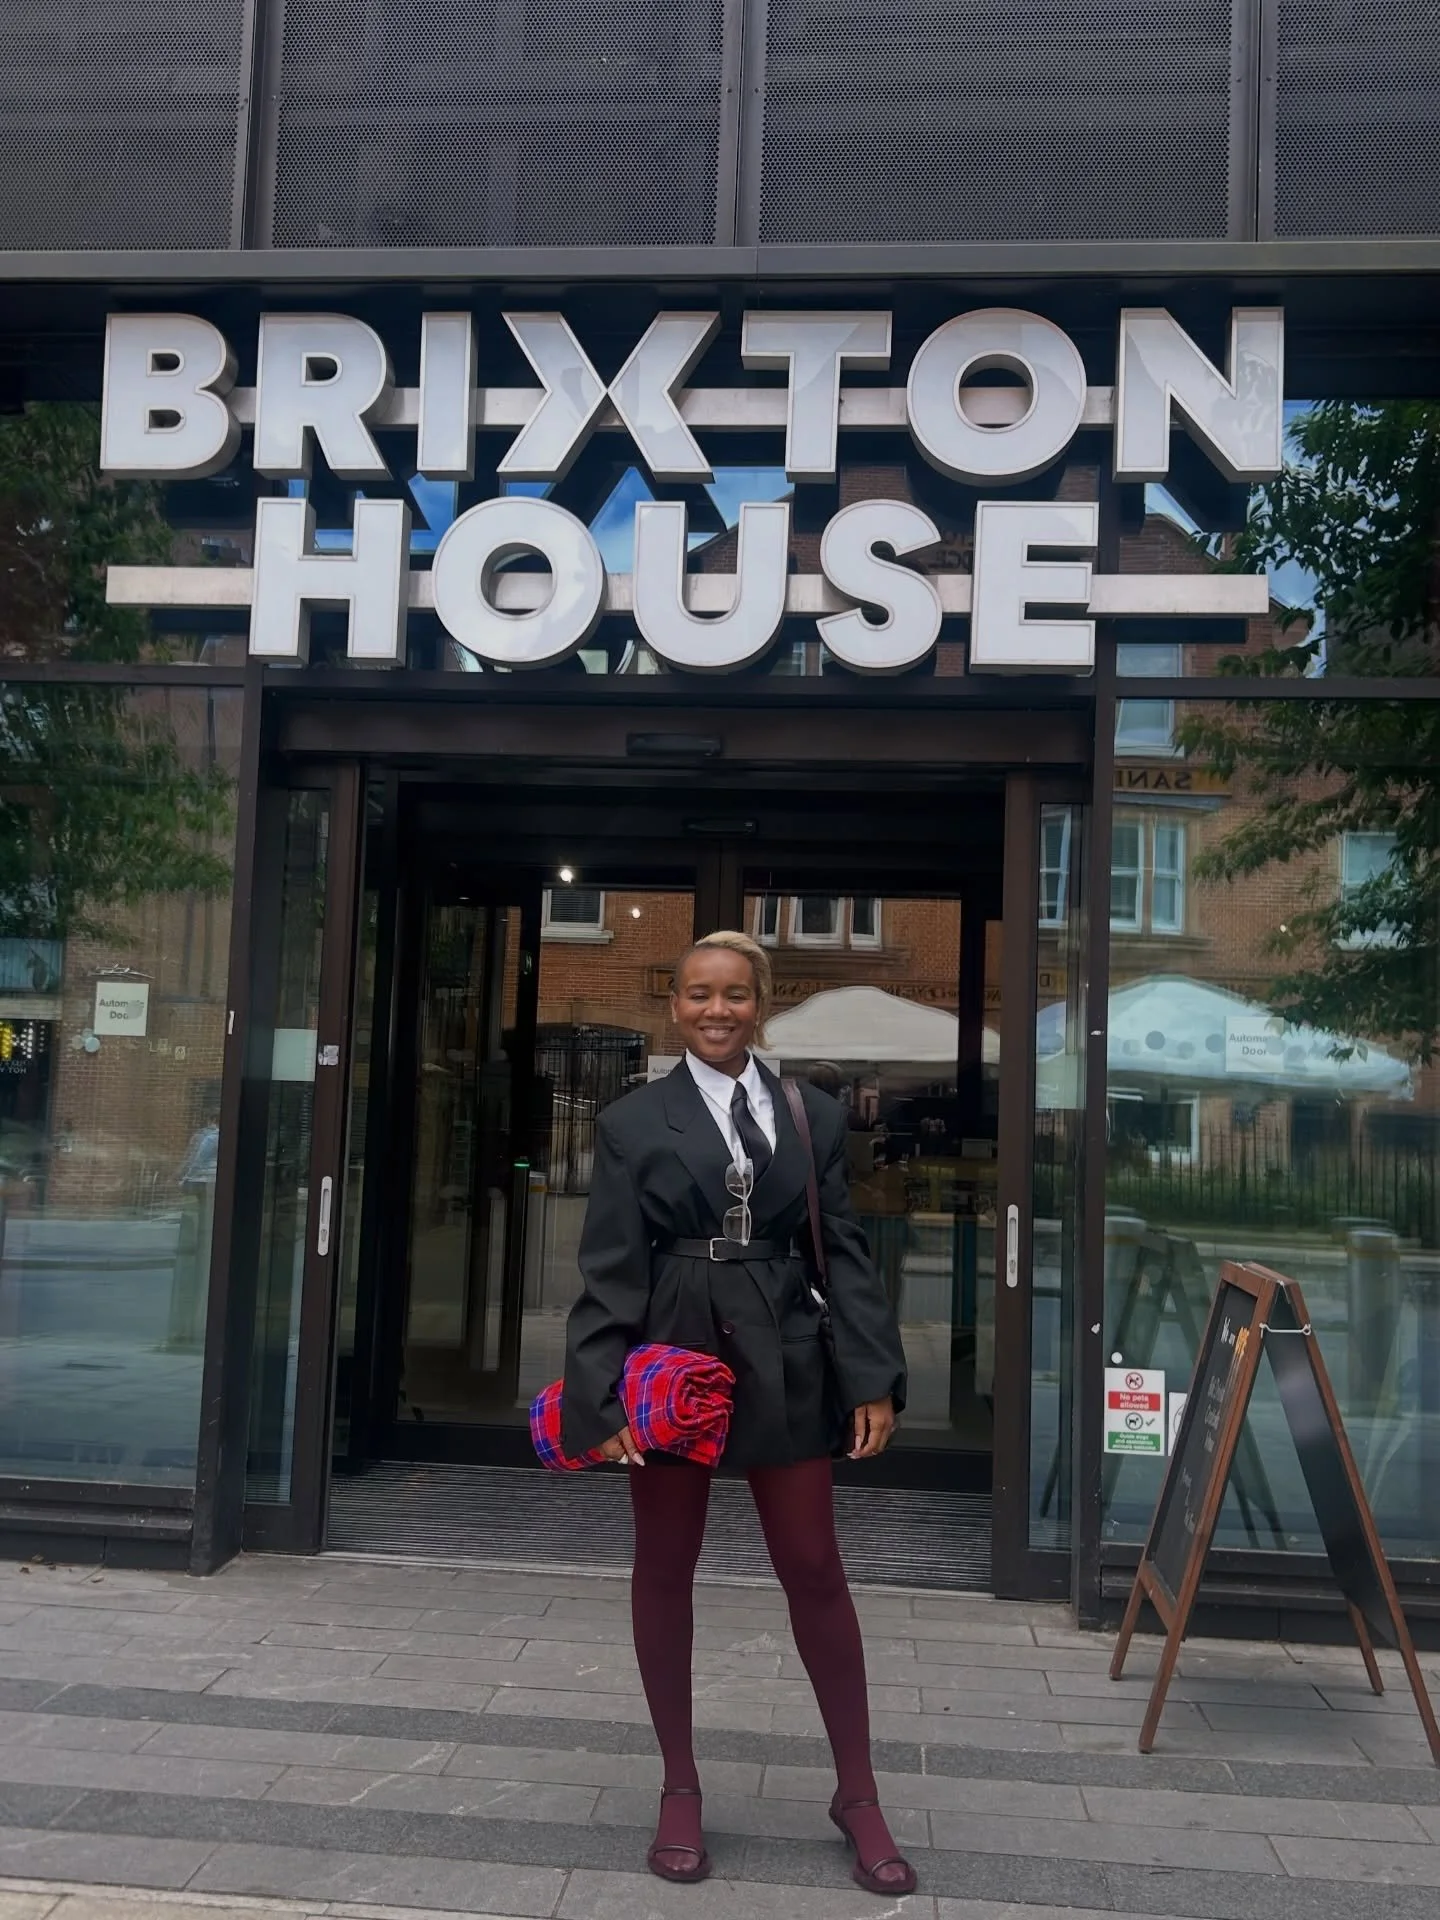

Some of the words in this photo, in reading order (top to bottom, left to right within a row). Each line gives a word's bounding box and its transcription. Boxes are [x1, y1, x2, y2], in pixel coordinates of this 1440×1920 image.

[100, 307, 1284, 486] BRIXTON
[249, 497, 1099, 676] HOUSE
[1229, 1033, 1269, 1042] Automa
[1120, 1392, 1131, 1400] No
[1132, 1394, 1149, 1402] pets
